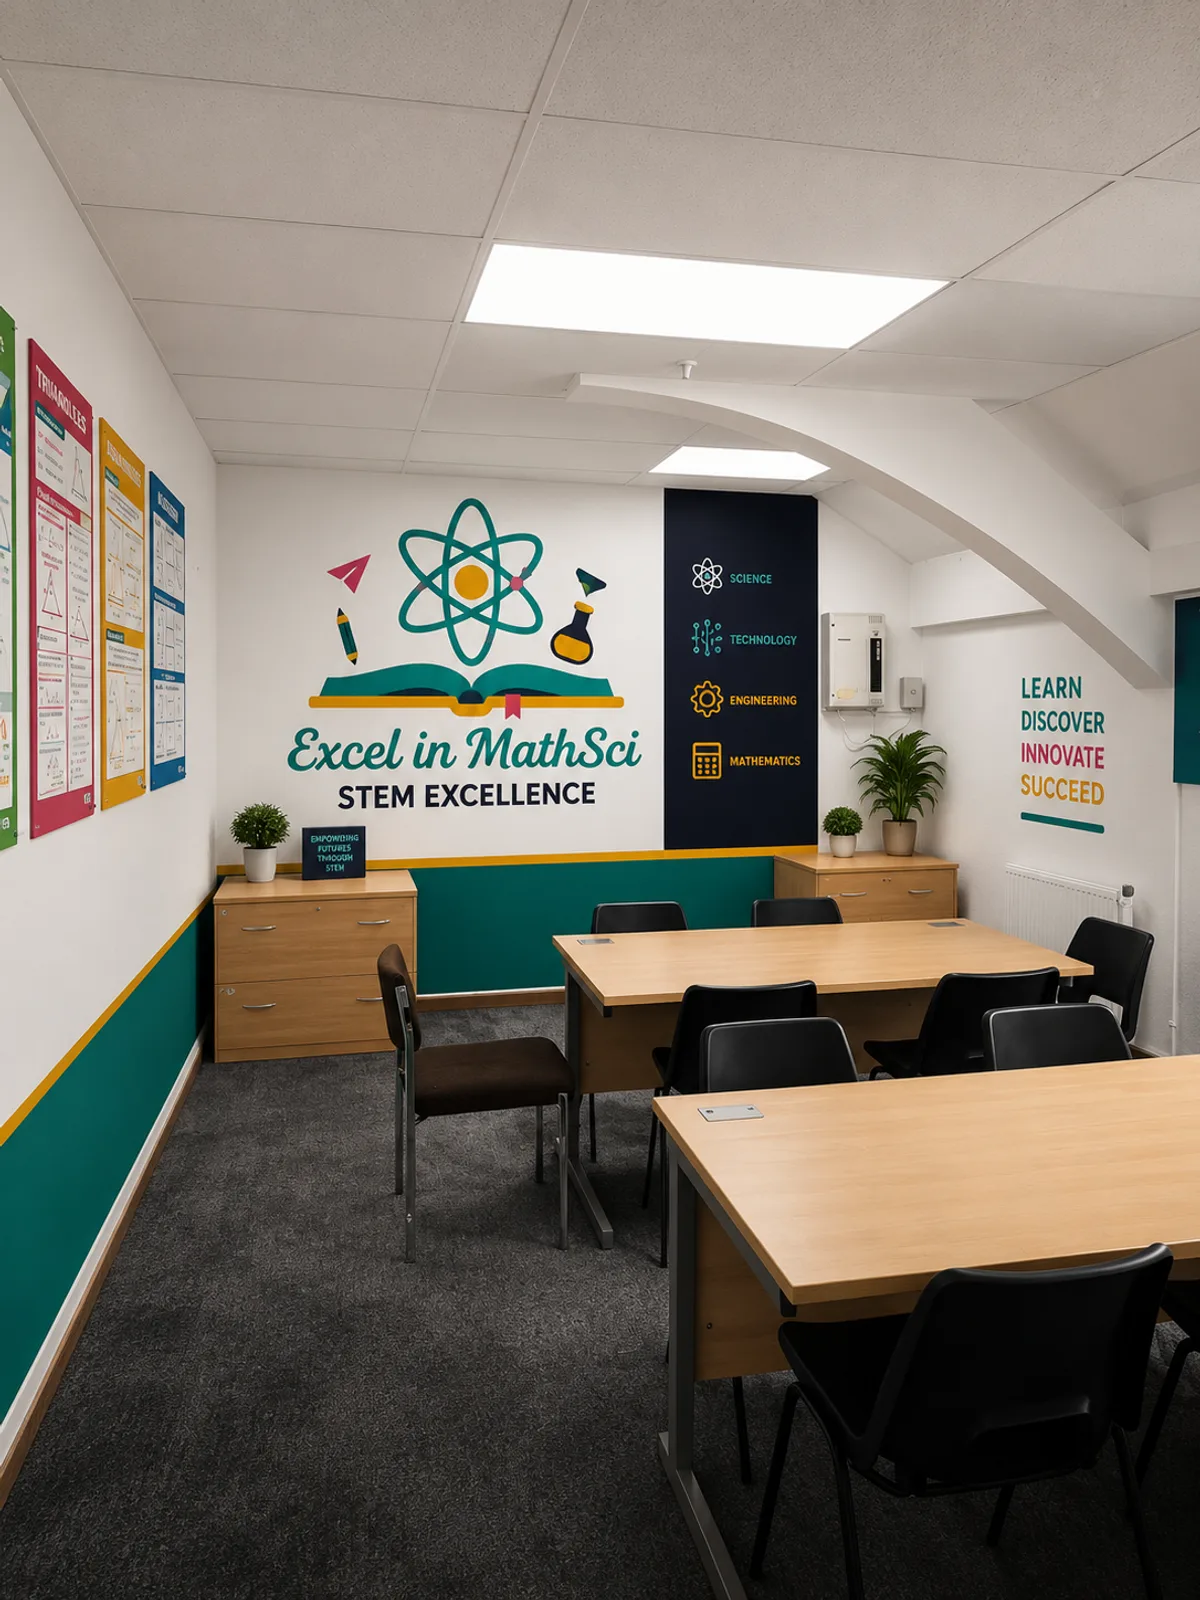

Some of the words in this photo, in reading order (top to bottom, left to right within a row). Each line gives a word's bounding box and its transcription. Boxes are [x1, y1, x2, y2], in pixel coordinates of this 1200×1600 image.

[729, 573, 773, 585] SCIENCE
[729, 634, 798, 646] TECHNOLOGY
[1021, 676, 1082, 699] LEARN
[729, 695, 798, 706] ENGINEERING
[1021, 710, 1105, 734] DISCOVER
[287, 727, 403, 772] Excel
[413, 731, 457, 769] in
[466, 727, 642, 770] MathSci
[729, 755, 801, 767] MATHEMATICS
[1021, 742, 1105, 769] INNOVATE
[337, 784, 415, 810] STEM
[425, 781, 596, 808] EXCELLENCE
[1021, 773, 1105, 806] SUCCEED
[325, 863, 345, 872] STEM
